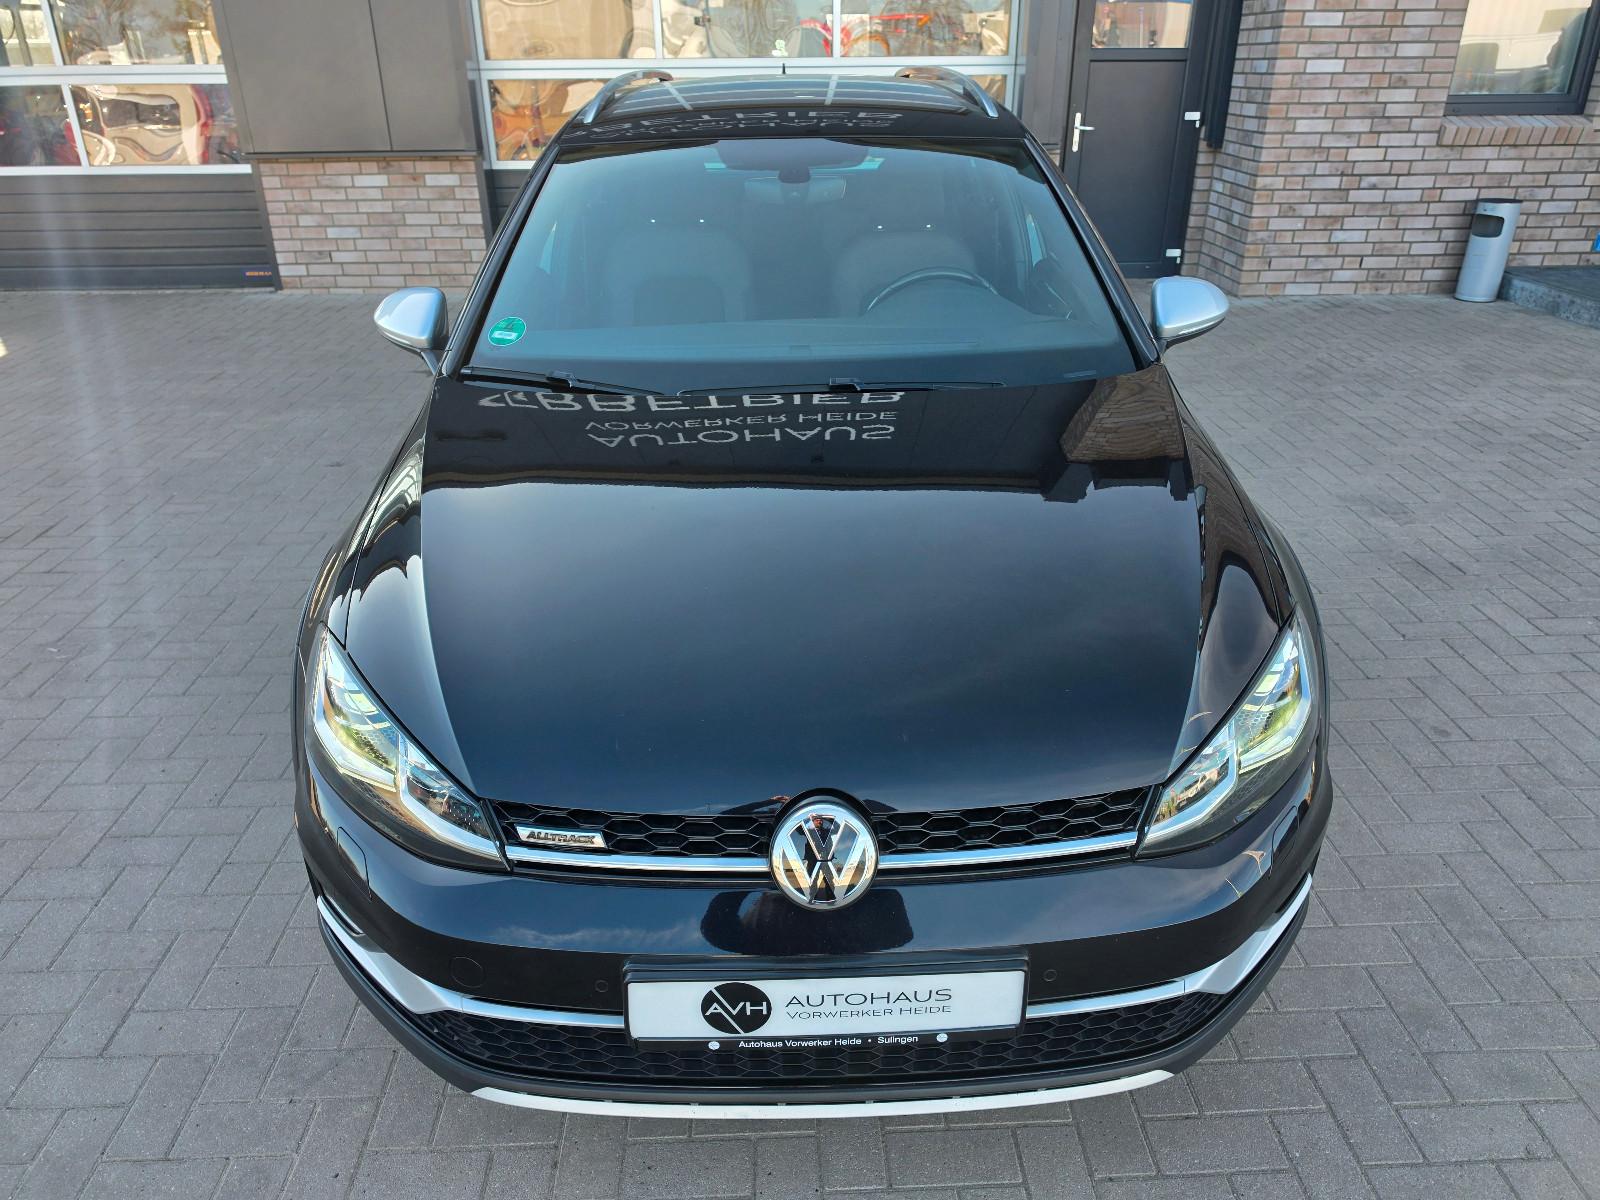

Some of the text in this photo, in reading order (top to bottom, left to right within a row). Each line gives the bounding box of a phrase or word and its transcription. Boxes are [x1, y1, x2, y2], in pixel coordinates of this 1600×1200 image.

[526, 830, 596, 844] ALLTRACK
[785, 988, 953, 1008] AUTOHAUS
[704, 1000, 769, 1016] AVH
[785, 1005, 953, 1020] VORWERKER HEIDE
[738, 1035, 919, 1048] Autohaus Vorwerker Heide Sulingen
